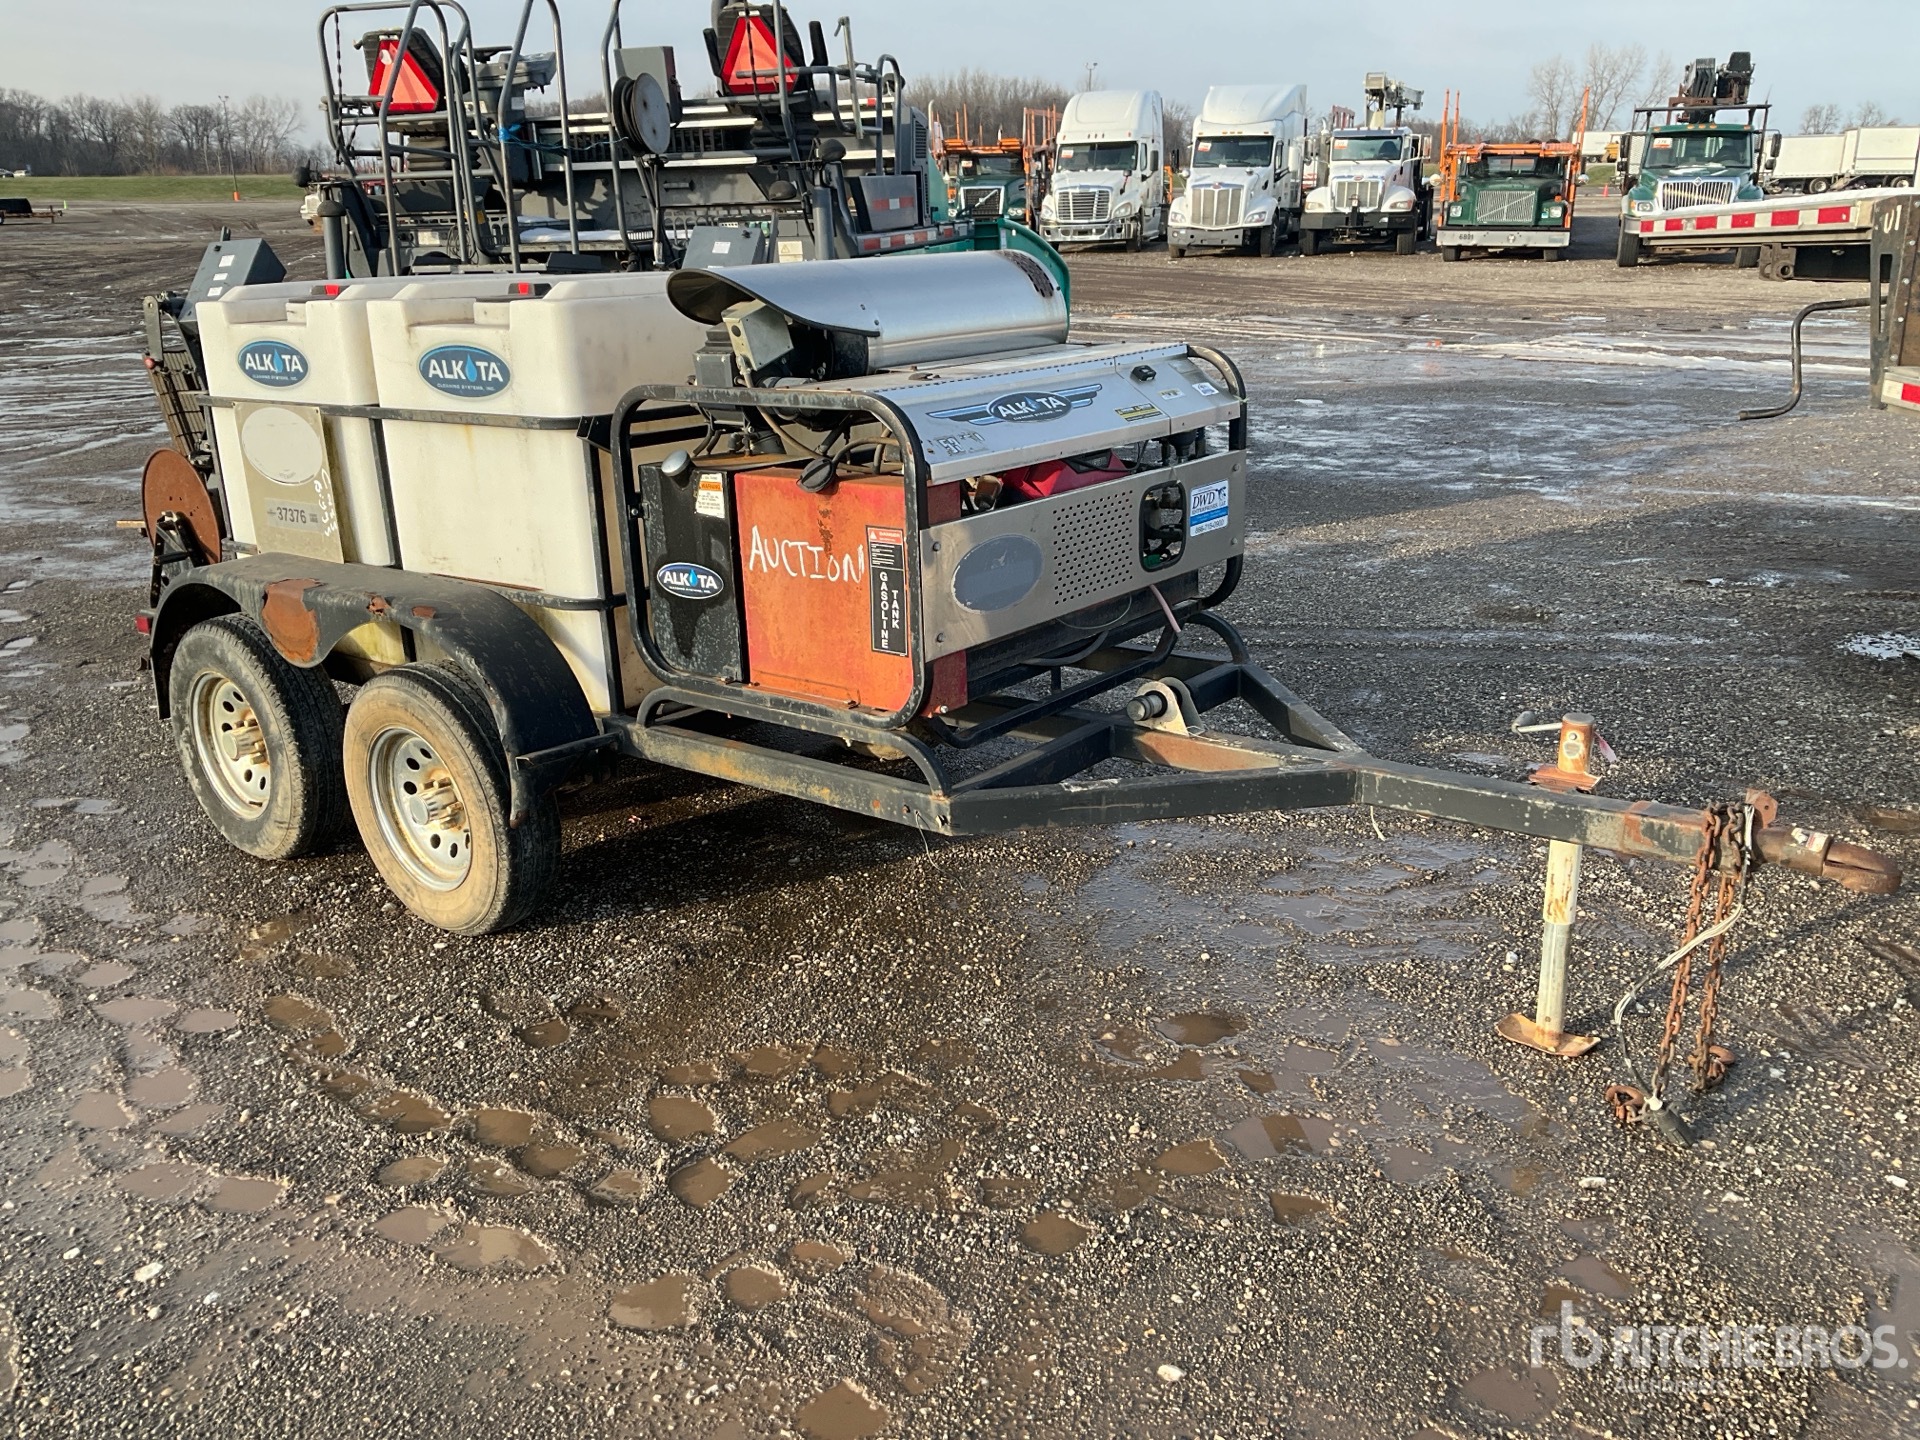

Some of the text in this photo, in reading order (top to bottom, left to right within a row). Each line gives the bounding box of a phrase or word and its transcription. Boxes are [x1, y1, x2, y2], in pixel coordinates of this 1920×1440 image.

[276, 506, 307, 524] 37376
[1192, 491, 1216, 510] DWD
[749, 525, 865, 584] AUCTION
[879, 571, 890, 649] GASOLINE
[891, 589, 900, 630] TANK
